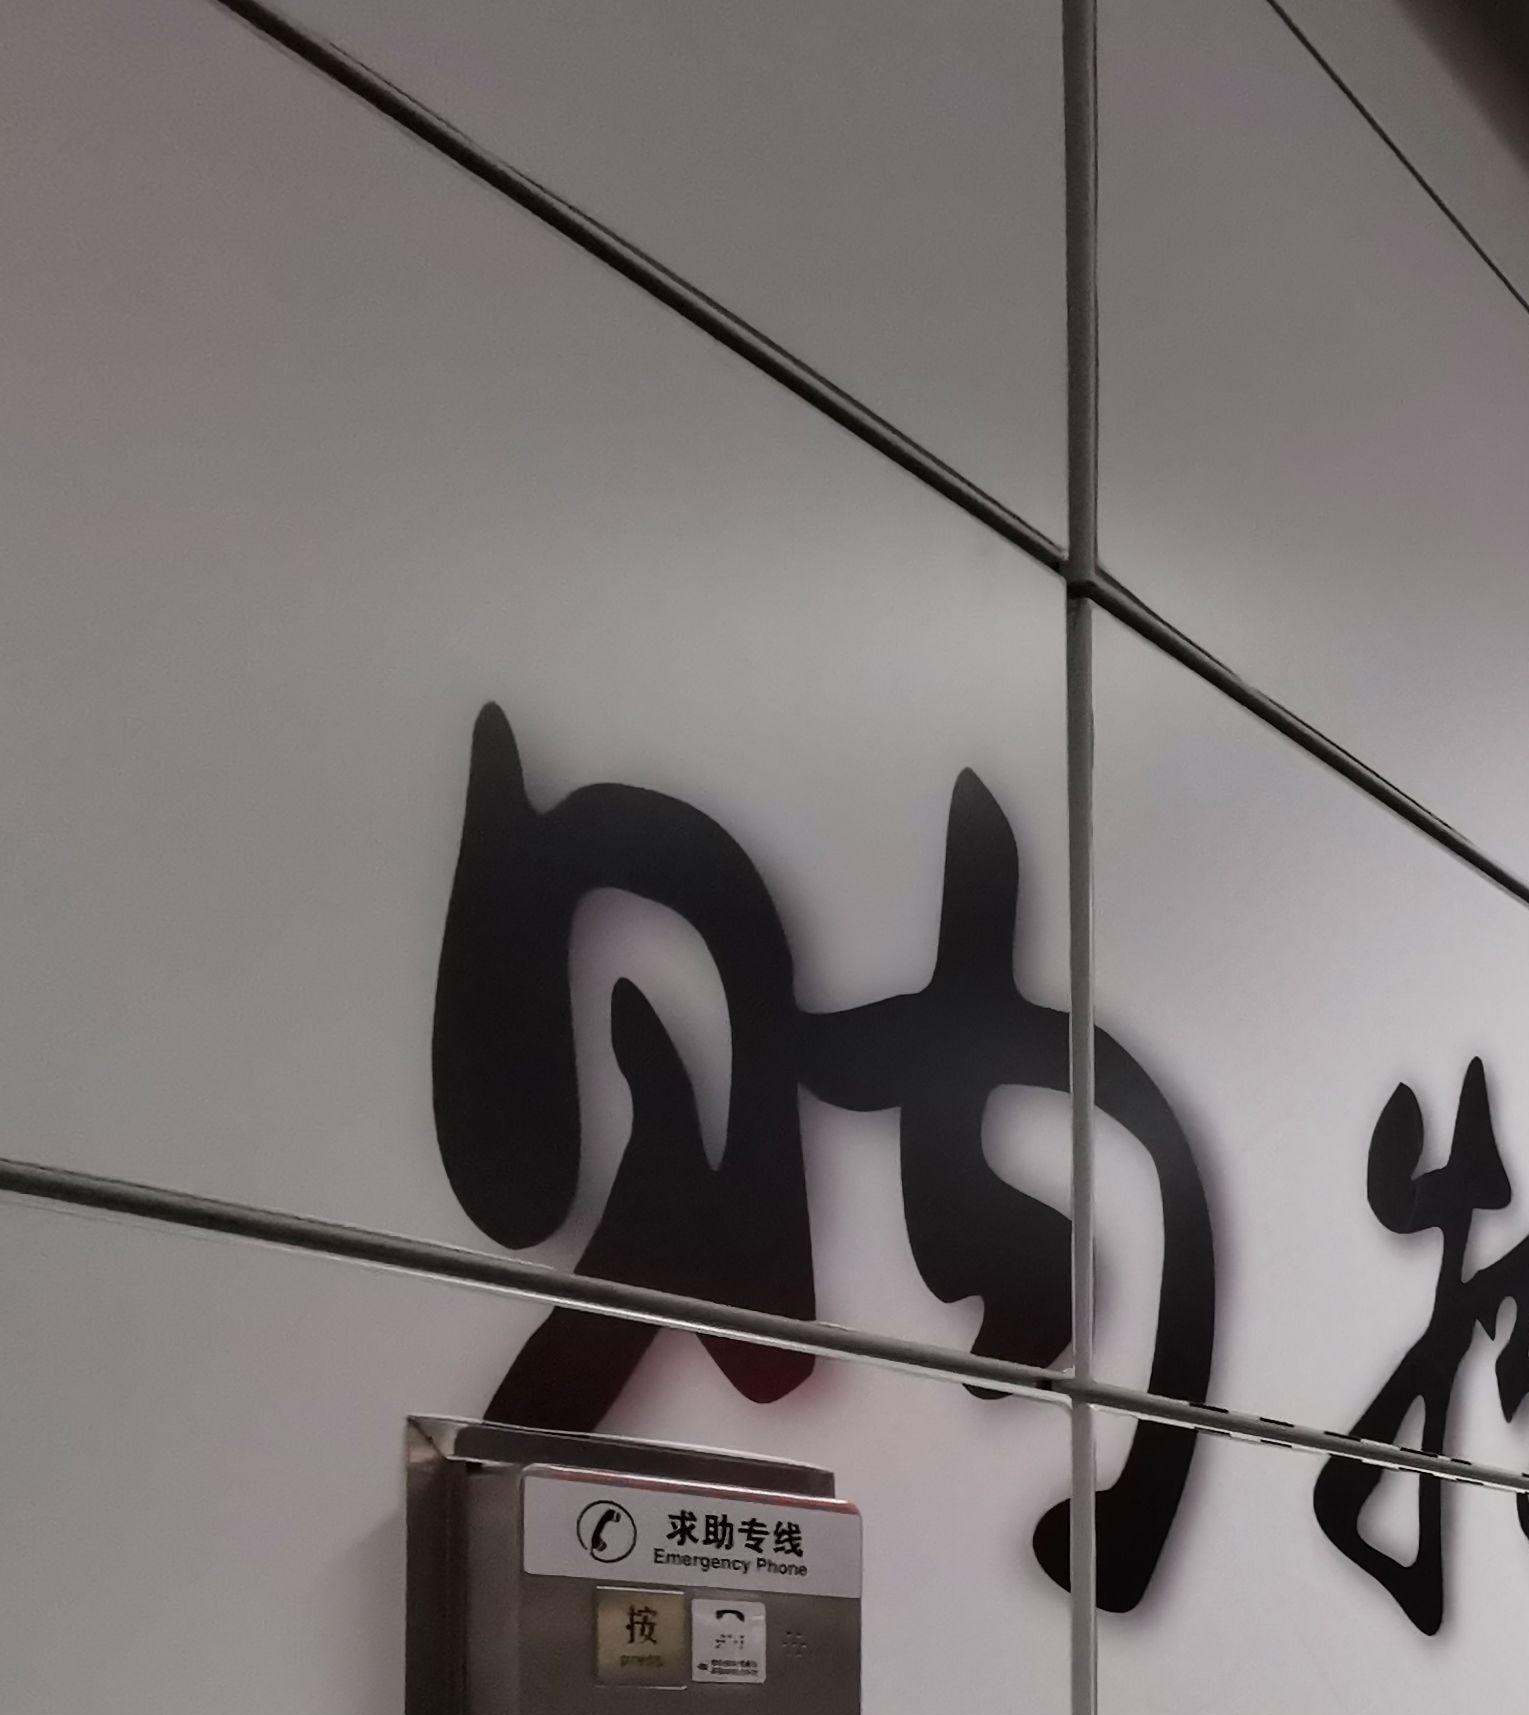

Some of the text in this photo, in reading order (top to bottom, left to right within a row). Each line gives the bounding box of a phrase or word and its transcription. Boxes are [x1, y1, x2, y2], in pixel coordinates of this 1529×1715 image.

[665, 1509, 805, 1557] 求助专线
[653, 1548, 808, 1577] Emergency Phone
[625, 1605, 658, 1645] 按
